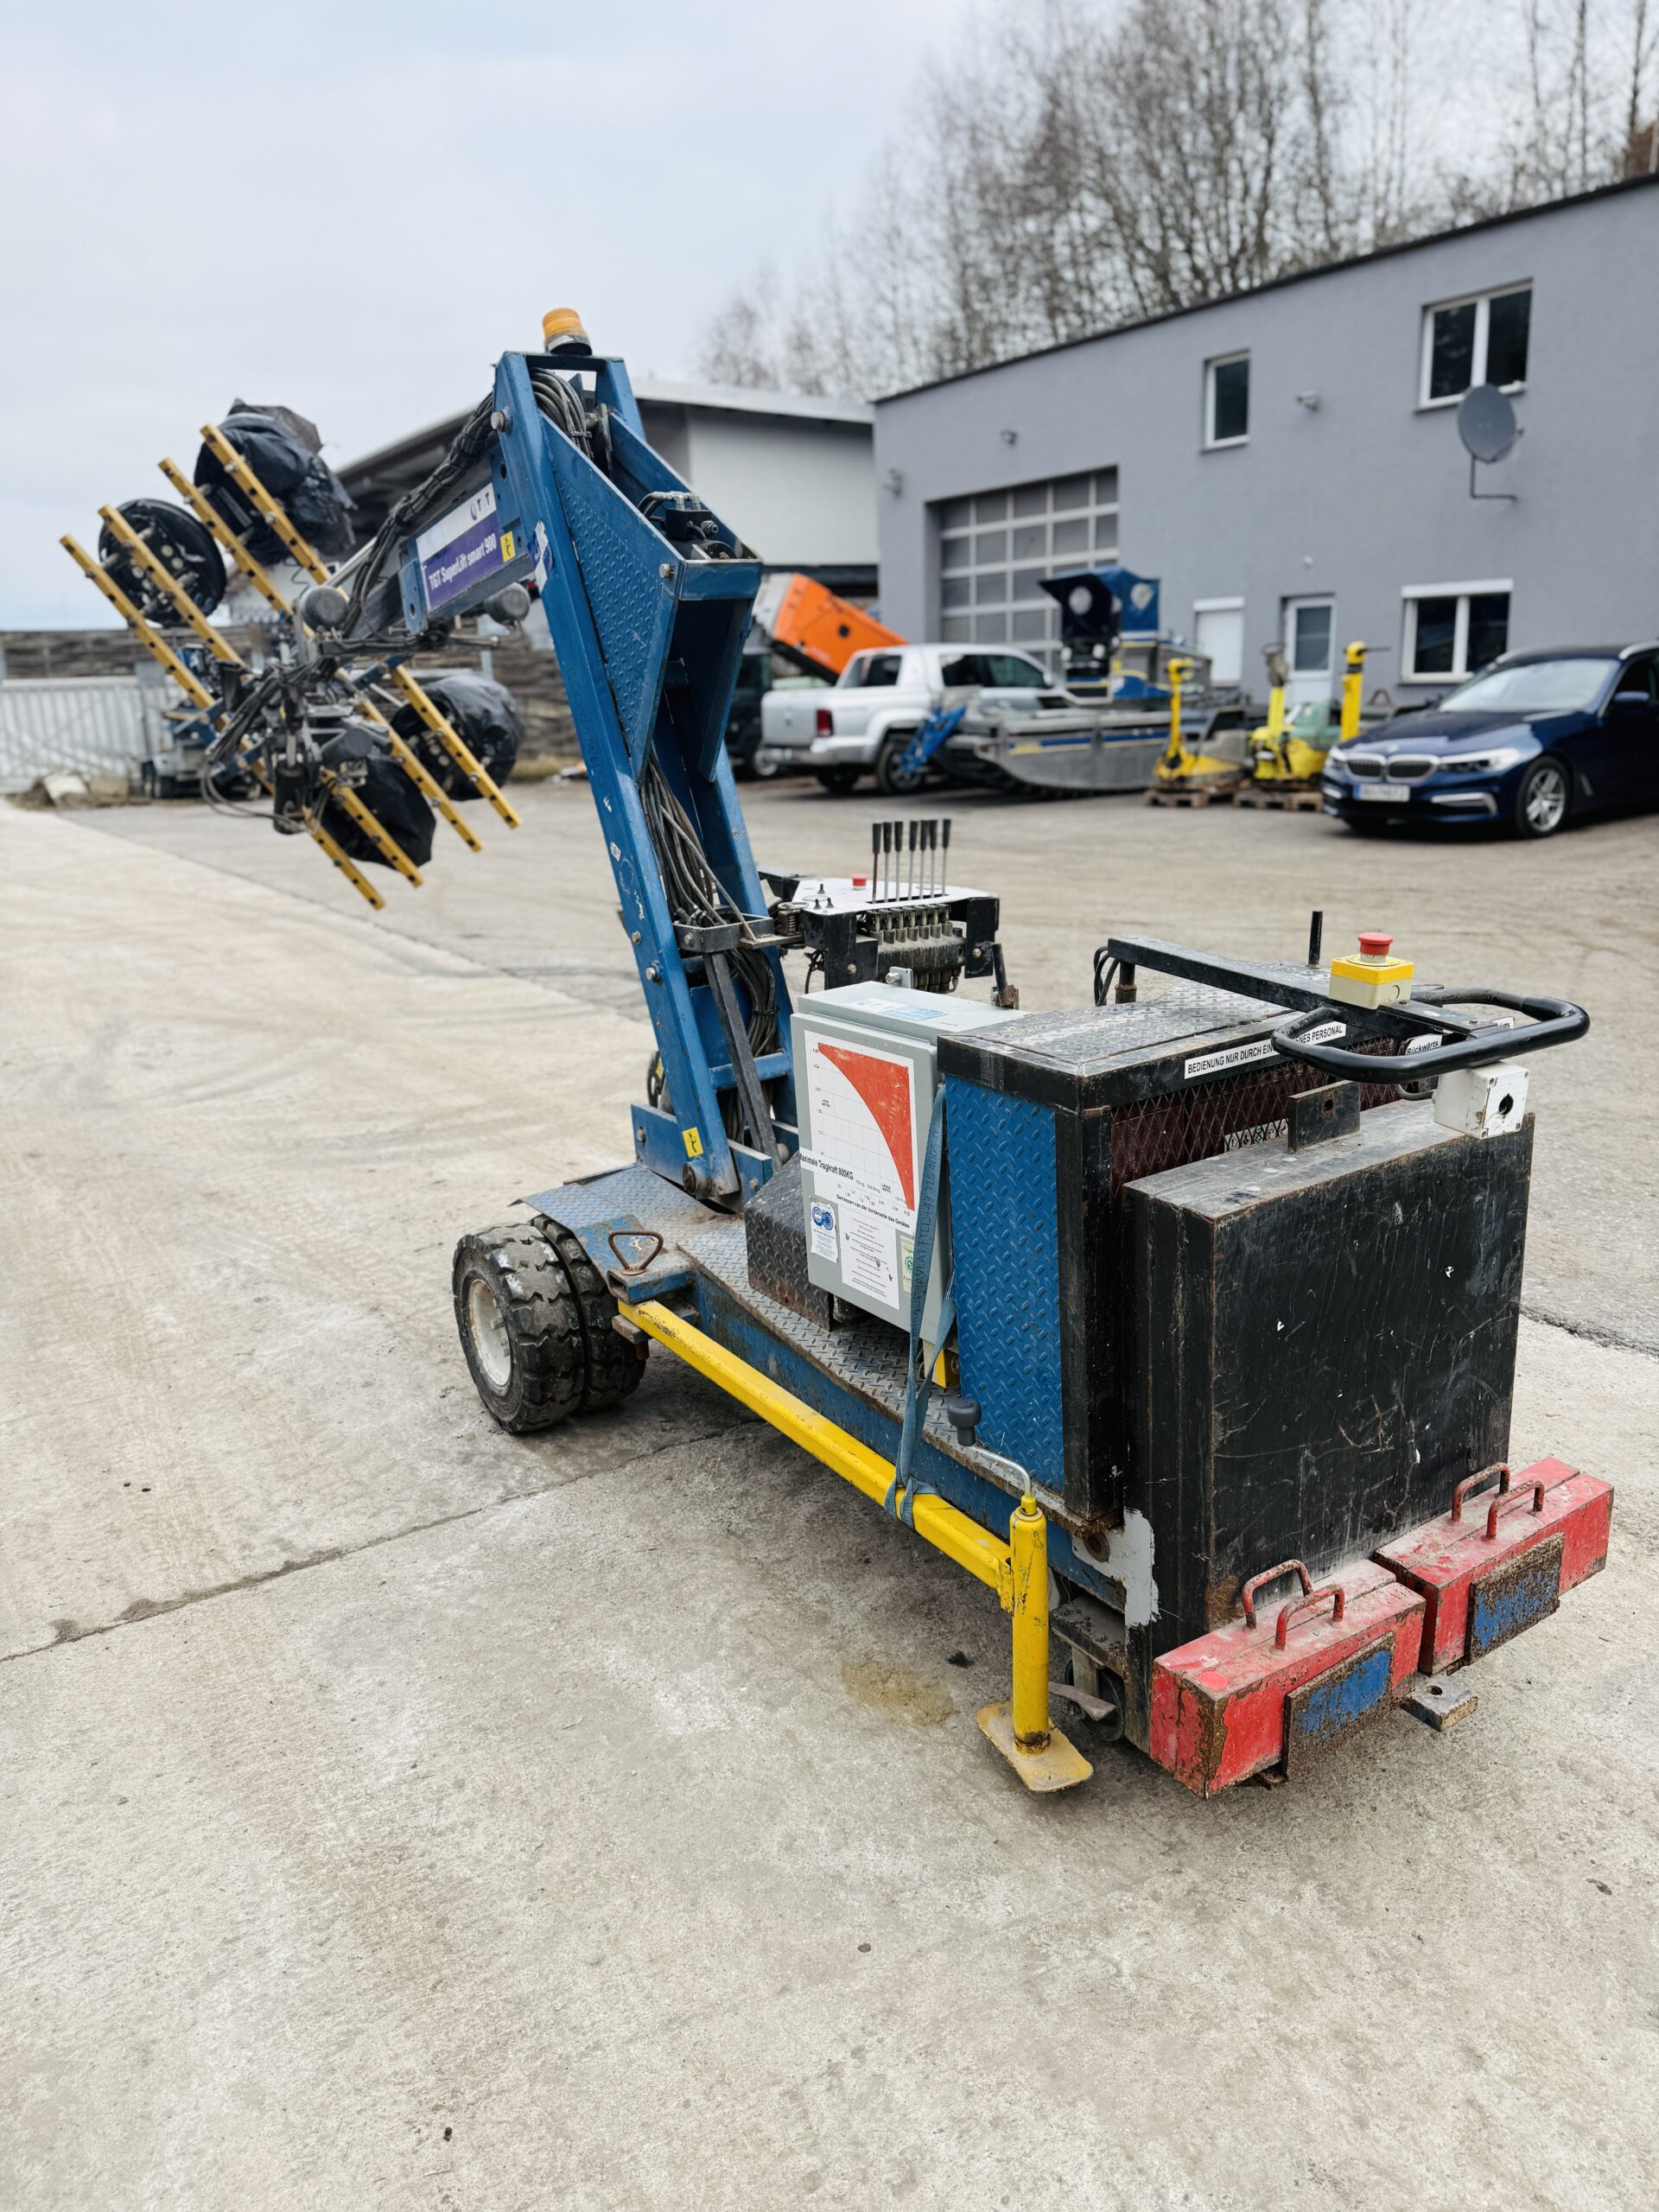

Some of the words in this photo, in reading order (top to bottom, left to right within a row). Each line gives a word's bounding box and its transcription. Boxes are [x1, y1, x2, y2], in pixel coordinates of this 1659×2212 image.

[429, 569, 442, 590] TGT
[442, 553, 467, 582] SuperLift
[467, 543, 486, 566] smart
[484, 533, 497, 554] 900
[1188, 1058, 1224, 1074] BEDIENUNG
[1225, 1052, 1239, 1064] NUR
[1240, 1046, 1262, 1060] DURCH
[1312, 1026, 1343, 1042] PERSONAL
[1407, 1040, 1439, 1054] Rückwärts
[818, 1159, 838, 1174] Tragkraft
[838, 1167, 854, 1180] 800KG
[836, 1193, 854, 1205] Gemessen
[868, 1207, 887, 1219] Vorderseite
